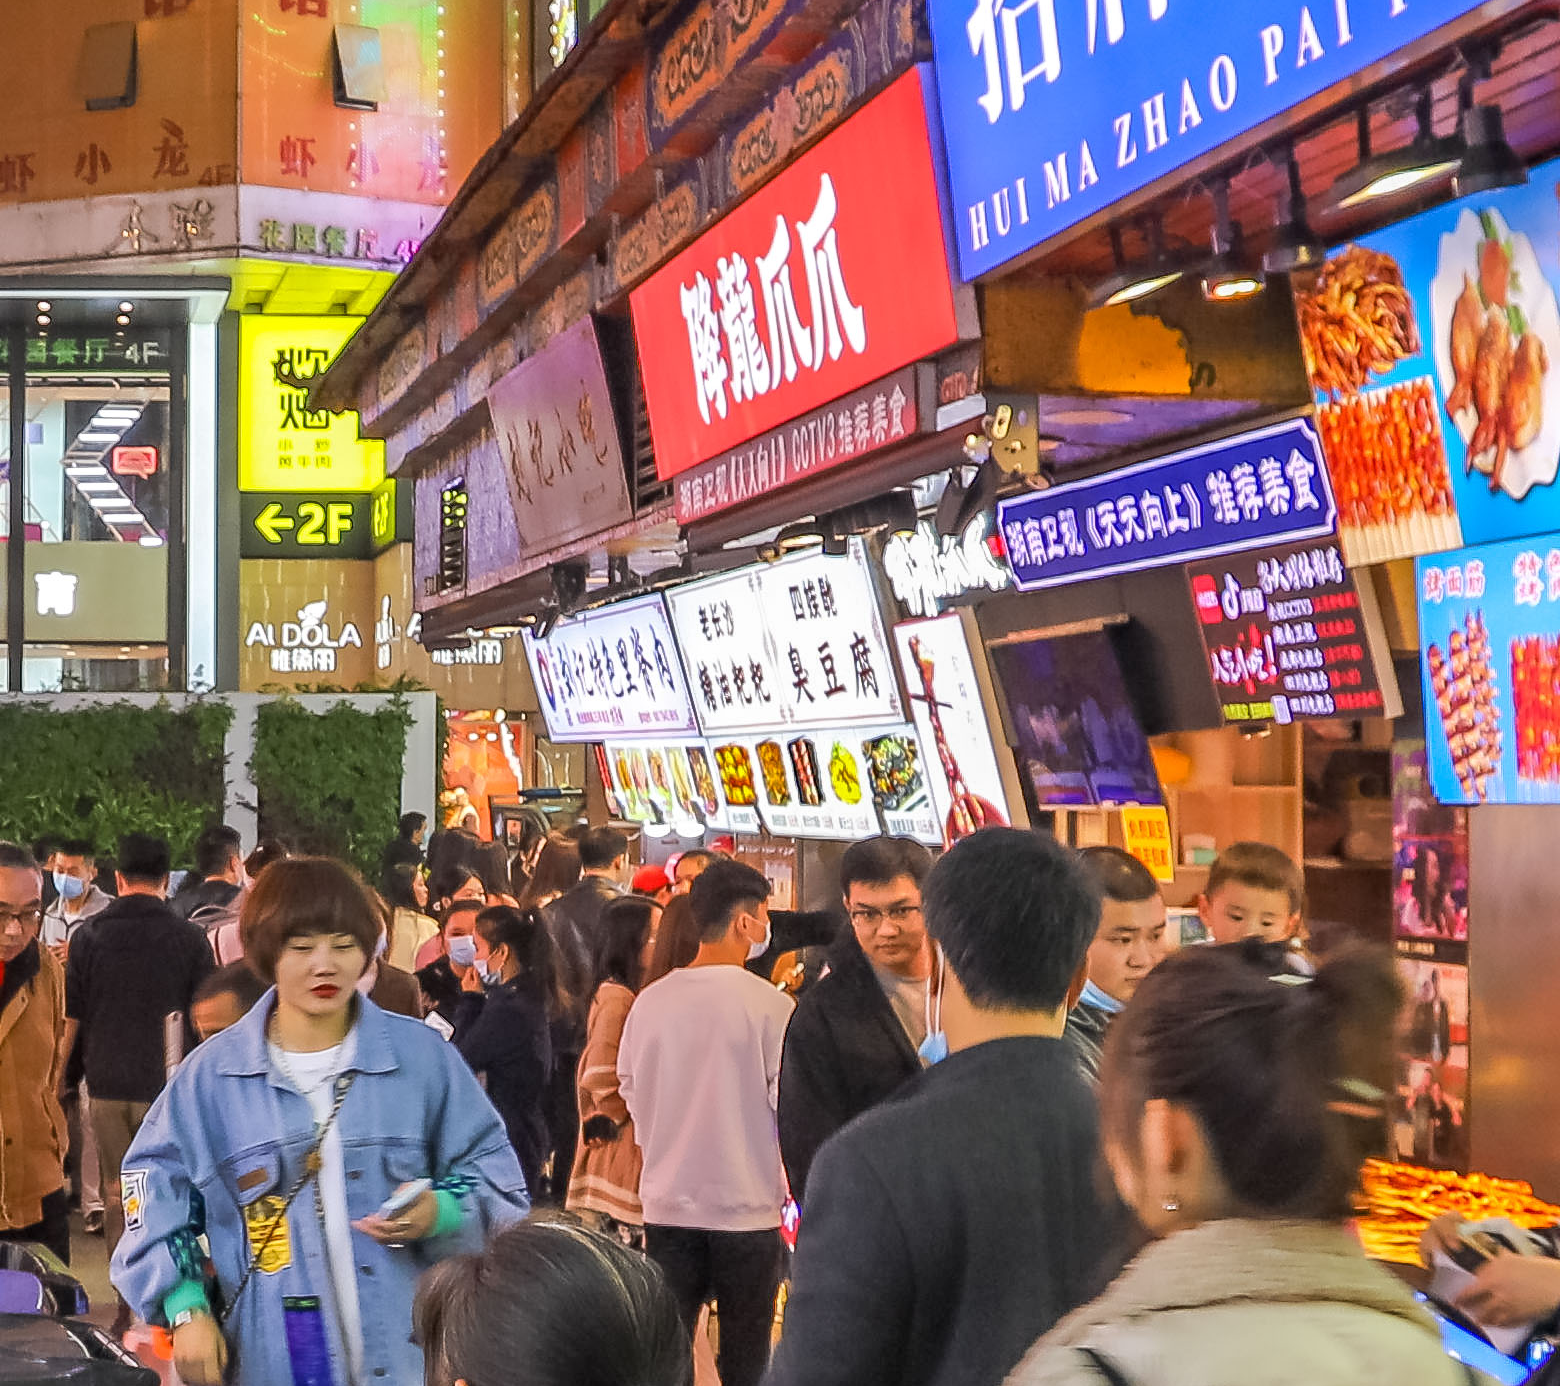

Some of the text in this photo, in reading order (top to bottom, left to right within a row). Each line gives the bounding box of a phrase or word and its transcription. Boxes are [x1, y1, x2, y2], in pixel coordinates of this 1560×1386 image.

[968, 194, 1029, 252] HUI
[1046, 149, 1098, 211] MA
[1114, 55, 1239, 169] ZHAO
[678, 169, 869, 425] 降龍爪爪
[792, 416, 836, 474] CCTV3
[838, 383, 909, 453] 推荐美食
[295, 502, 355, 546] 2F
[1205, 446, 1321, 525] 推荐美食
[696, 597, 736, 644] 老长沙
[786, 630, 882, 705] 臭豆腐
